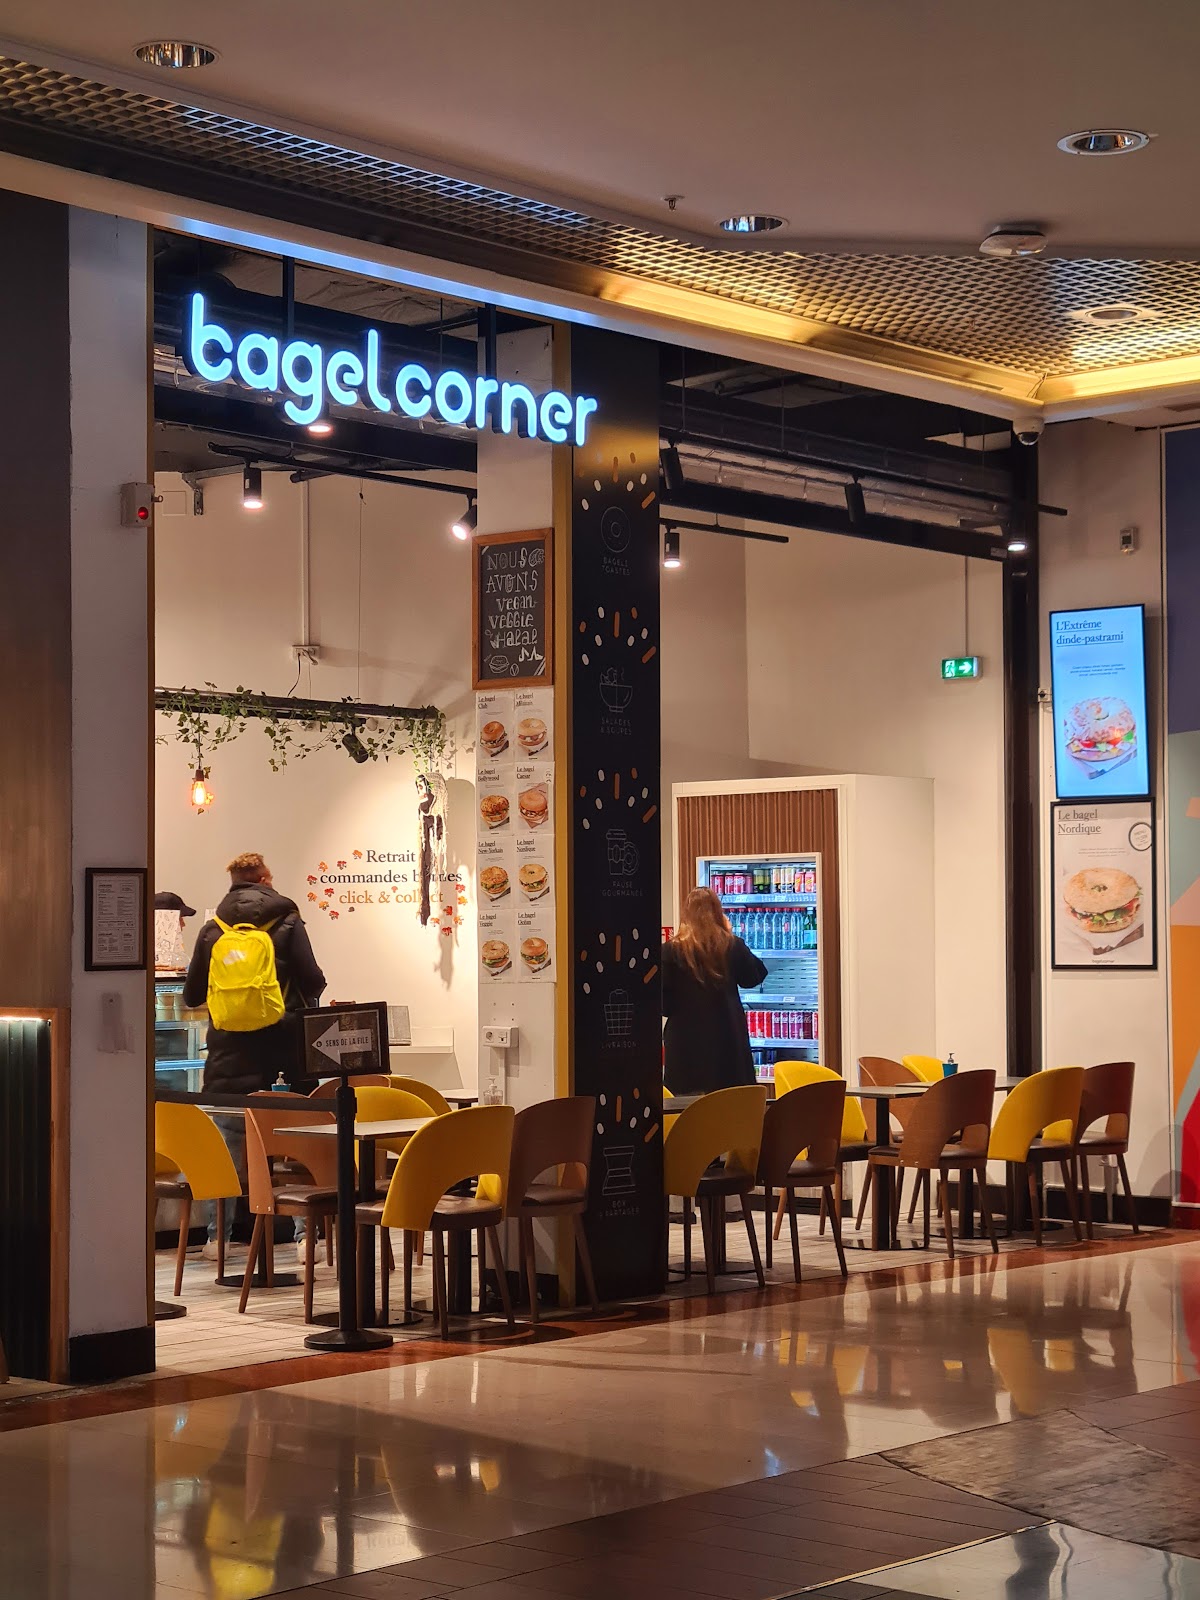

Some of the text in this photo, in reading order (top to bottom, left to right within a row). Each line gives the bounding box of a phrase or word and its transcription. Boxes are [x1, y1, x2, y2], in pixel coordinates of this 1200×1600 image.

[487, 547, 528, 571] NOUS
[486, 570, 539, 594] AVONS
[1056, 631, 1124, 645] dinde-pastrami
[1058, 809, 1098, 821] Le bagel
[1058, 823, 1101, 835] Nordique
[366, 849, 416, 863] Retrait
[320, 869, 463, 883] commandes brnes
[339, 890, 373, 904] click
[378, 891, 391, 904] &
[325, 1039, 339, 1047] SENS
